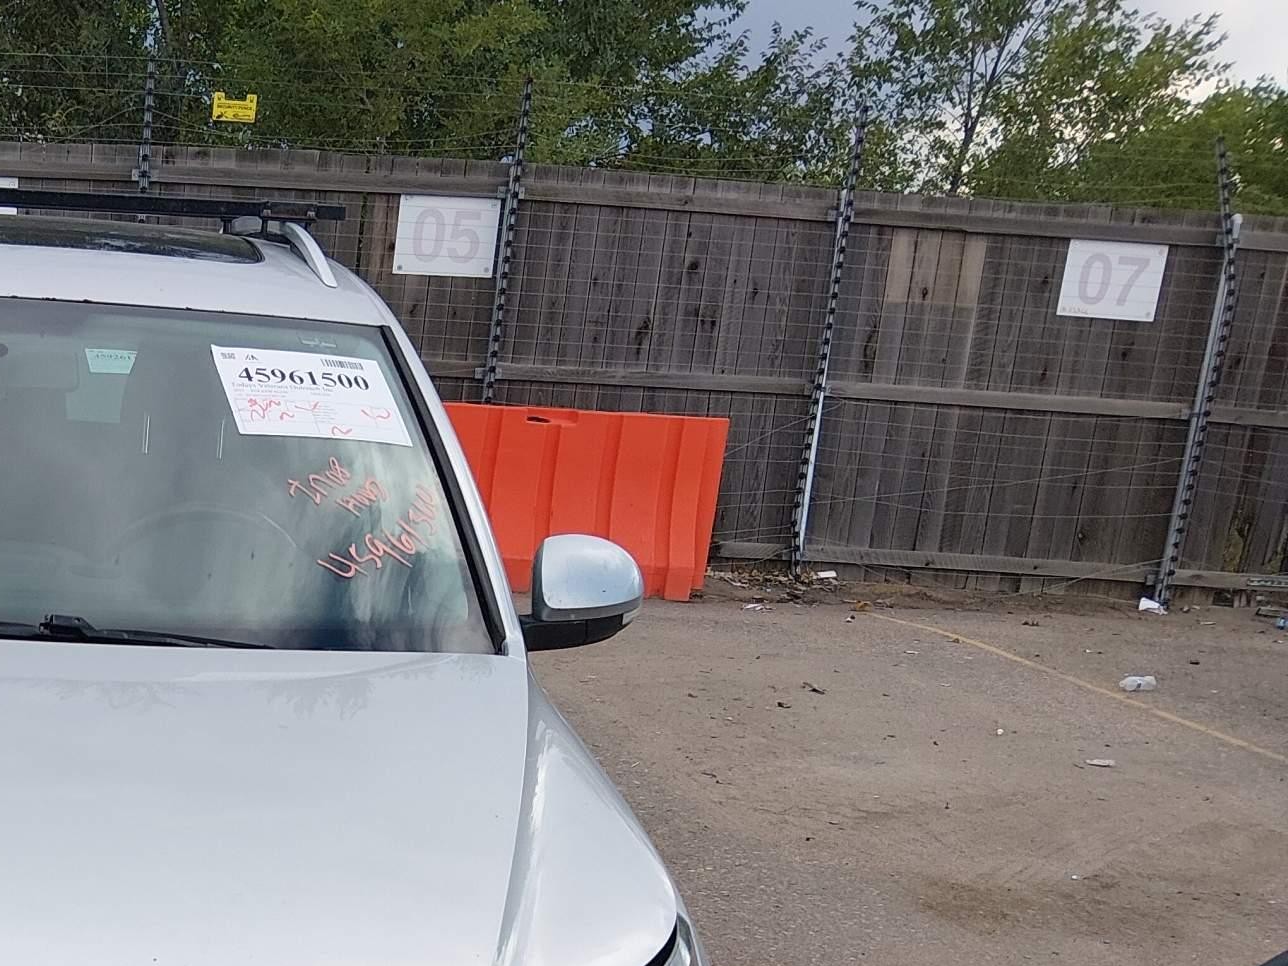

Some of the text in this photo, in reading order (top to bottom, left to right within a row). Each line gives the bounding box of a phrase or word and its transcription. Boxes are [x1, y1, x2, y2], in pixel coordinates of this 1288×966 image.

[412, 207, 481, 264] 05
[1078, 252, 1152, 307] 07
[238, 367, 370, 391] 45961500
